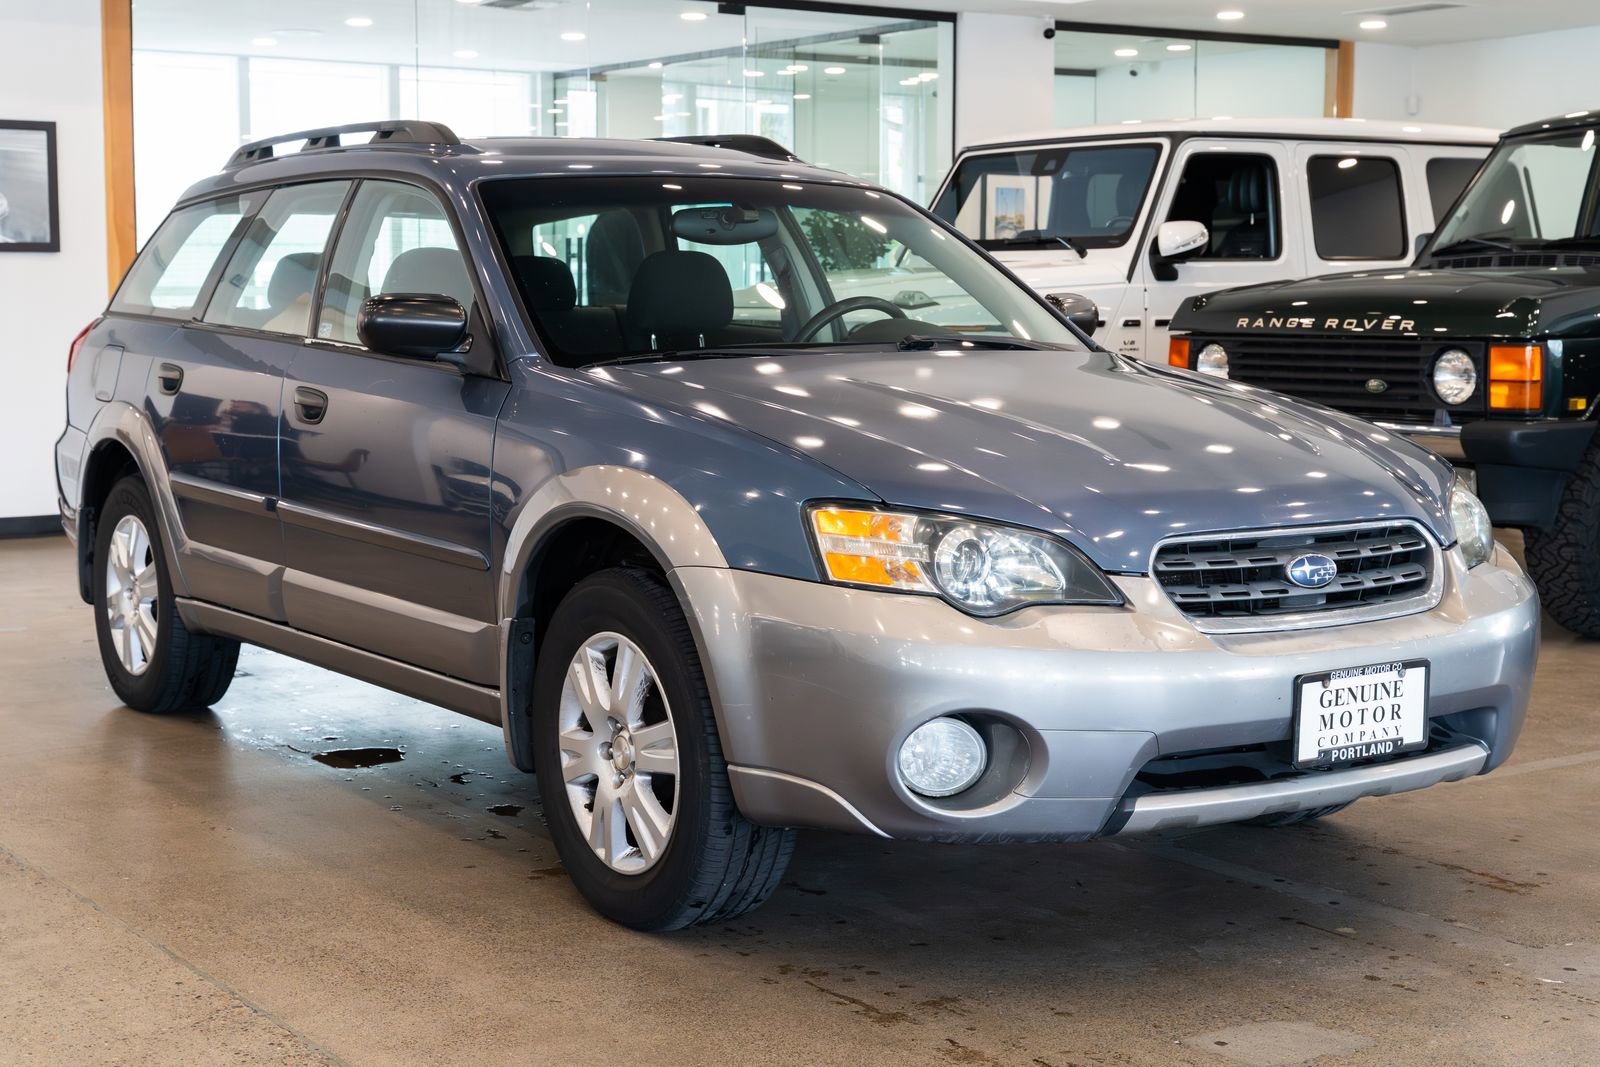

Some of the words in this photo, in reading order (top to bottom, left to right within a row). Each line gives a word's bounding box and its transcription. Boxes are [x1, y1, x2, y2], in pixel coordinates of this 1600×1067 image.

[1236, 317, 1315, 328] RANGE
[1325, 318, 1415, 331] ROVER
[1330, 669, 1363, 680] GENUINE
[1365, 664, 1391, 675] MOTOR
[1320, 680, 1404, 709] GENUINE
[1319, 703, 1402, 731] MOTOR
[1317, 725, 1402, 748] COMPANY
[1332, 741, 1393, 761] PORTLAND
